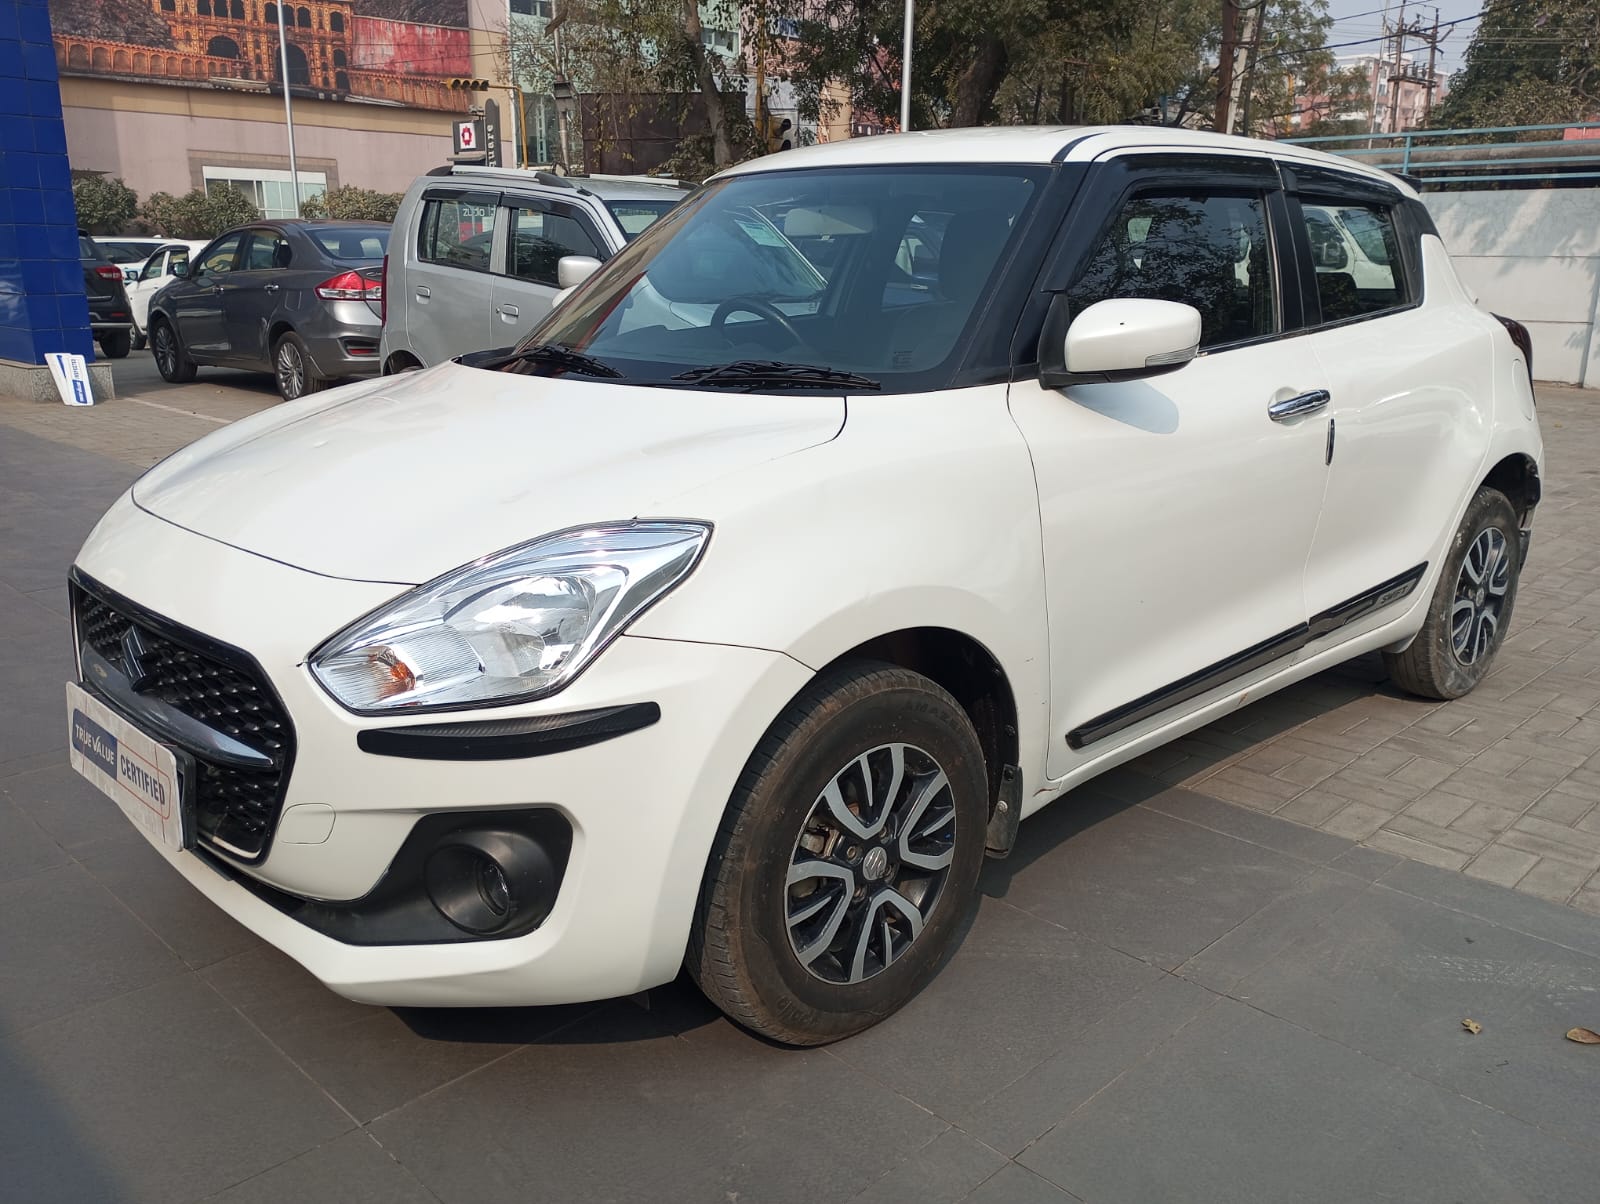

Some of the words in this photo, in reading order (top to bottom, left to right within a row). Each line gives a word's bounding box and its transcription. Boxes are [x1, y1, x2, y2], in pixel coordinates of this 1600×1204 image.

[75, 724, 92, 746] TRUE
[92, 735, 114, 765] VALUE
[120, 754, 165, 805] CERTIFIED
